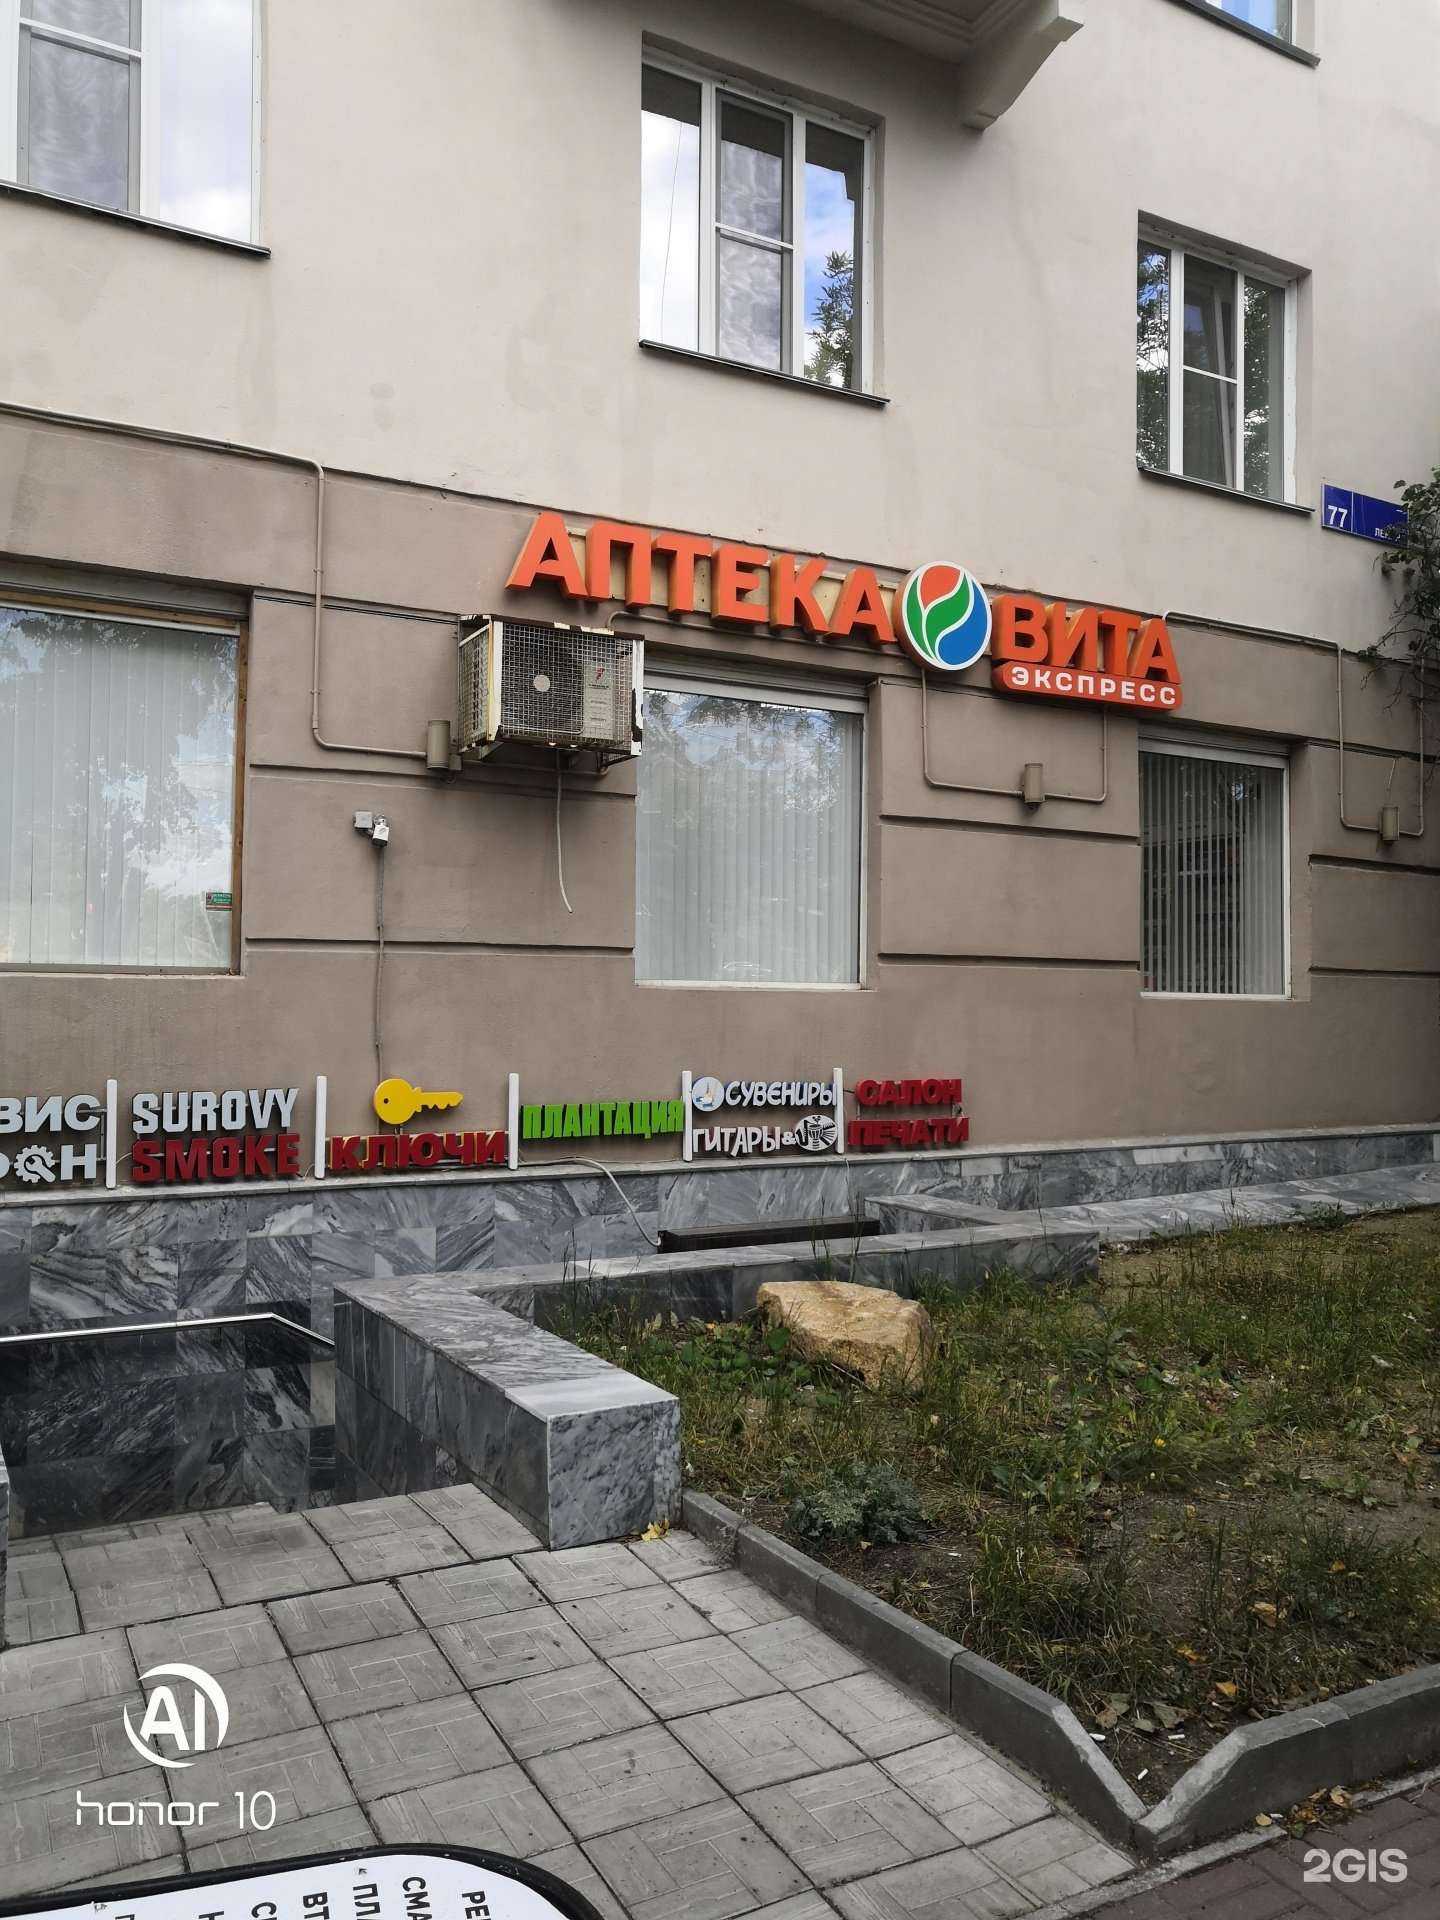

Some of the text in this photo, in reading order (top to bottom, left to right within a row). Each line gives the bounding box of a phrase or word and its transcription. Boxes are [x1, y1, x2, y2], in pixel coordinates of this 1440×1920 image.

[1326, 504, 1348, 528] 77
[505, 512, 1182, 685] АПТЕКА ВИТА
[1011, 666, 1176, 705] ЭКСПРЕСС
[132, 1088, 299, 1134] SUROVY
[725, 1080, 838, 1107] СУВЕНИРЫ
[855, 1079, 962, 1105] САЛОН
[0, 1095, 100, 1133] ВИС
[522, 1101, 685, 1140] ПЛАНТАЦИЯ
[848, 1117, 969, 1146] ПЕЧАТИ
[132, 1133, 300, 1182] SMOKE
[328, 1130, 506, 1169] КЛЮЧИ
[353, 1883, 381, 1920] ПЛ
[461, 1891, 492, 1920] РЕ
